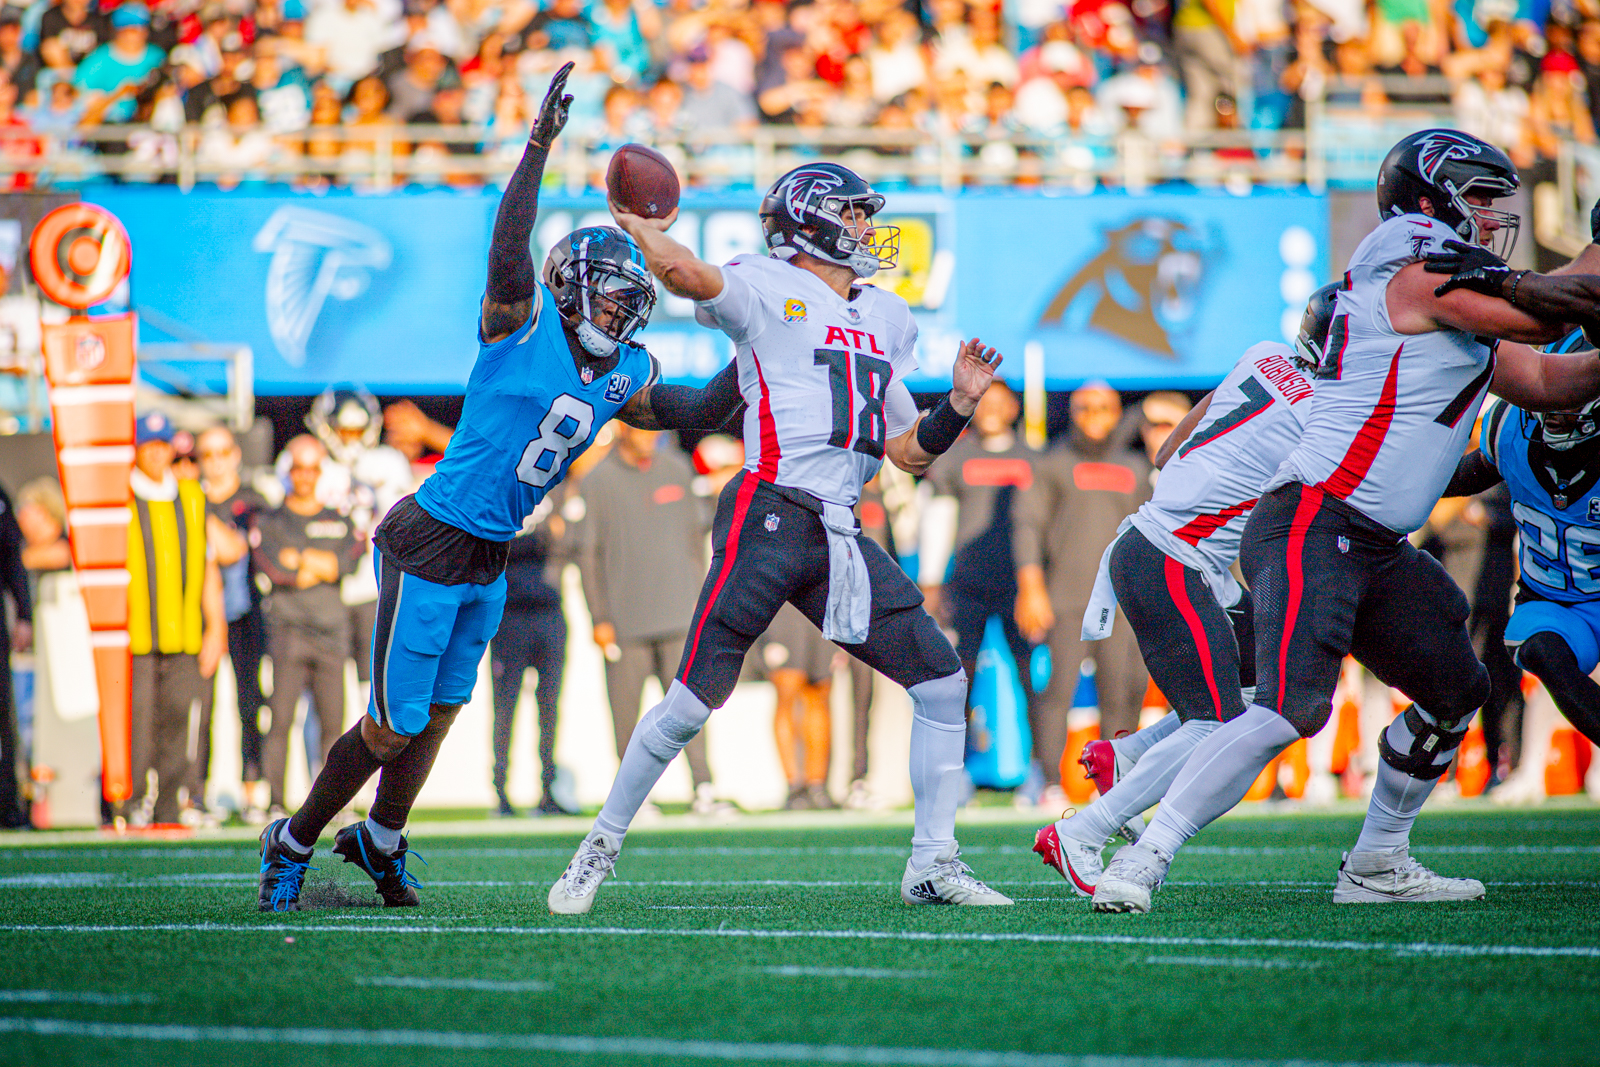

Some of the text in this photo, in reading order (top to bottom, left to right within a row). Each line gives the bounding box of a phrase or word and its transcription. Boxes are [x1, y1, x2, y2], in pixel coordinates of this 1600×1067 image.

[824, 325, 885, 356] ATL
[609, 372, 631, 395] 30
[813, 348, 894, 461] 18
[1253, 354, 1315, 406] ROBINSON
[514, 391, 595, 489] 8
[1177, 374, 1276, 460] 7
[909, 888, 944, 902] adidas
